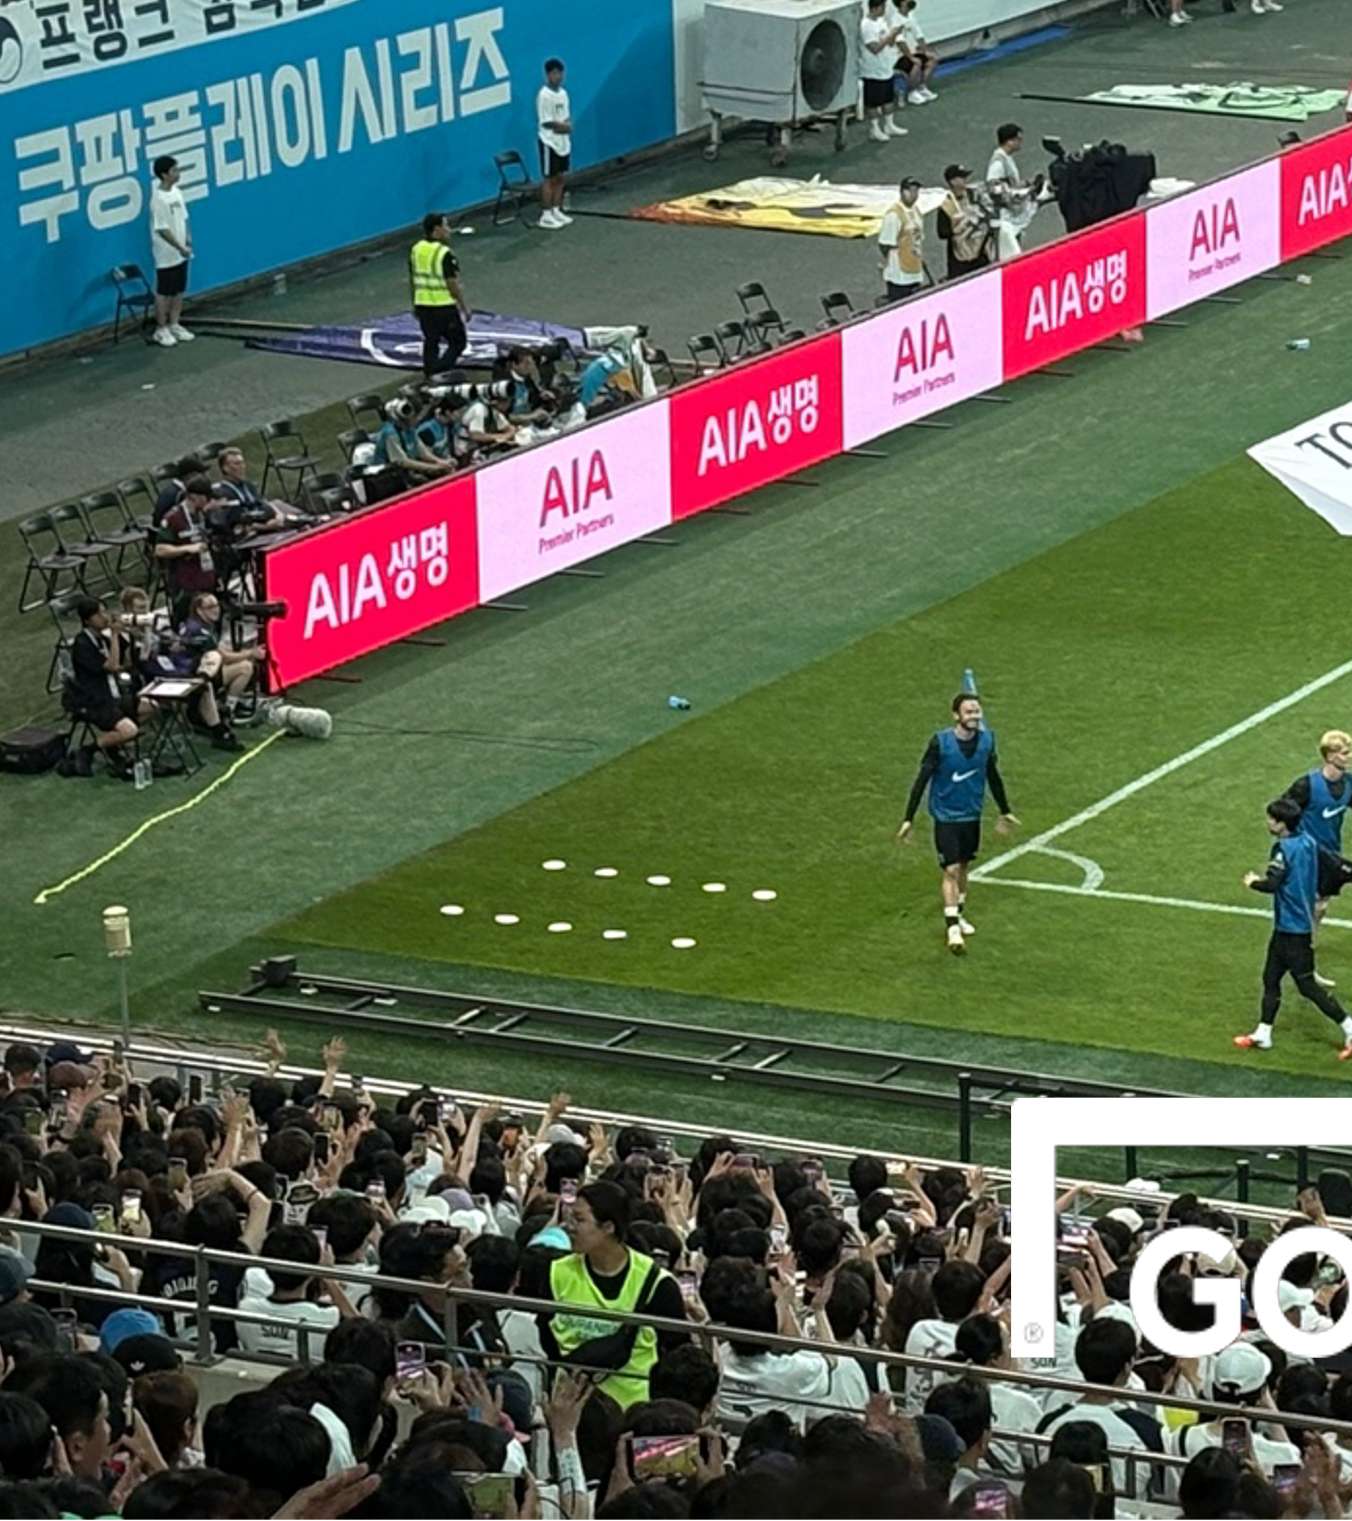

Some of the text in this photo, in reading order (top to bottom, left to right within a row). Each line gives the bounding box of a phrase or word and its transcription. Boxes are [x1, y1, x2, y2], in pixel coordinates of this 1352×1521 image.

[14, 6, 511, 243] 쿠팡플레이 시리즈
[1189, 197, 1240, 261] AIA
[1024, 249, 1128, 341] AIA생명
[893, 312, 955, 383] AIA
[697, 373, 819, 477] AIA생명
[539, 449, 613, 528] AIA
[538, 513, 614, 555] Premier Partners
[303, 519, 449, 639] AIA생명
